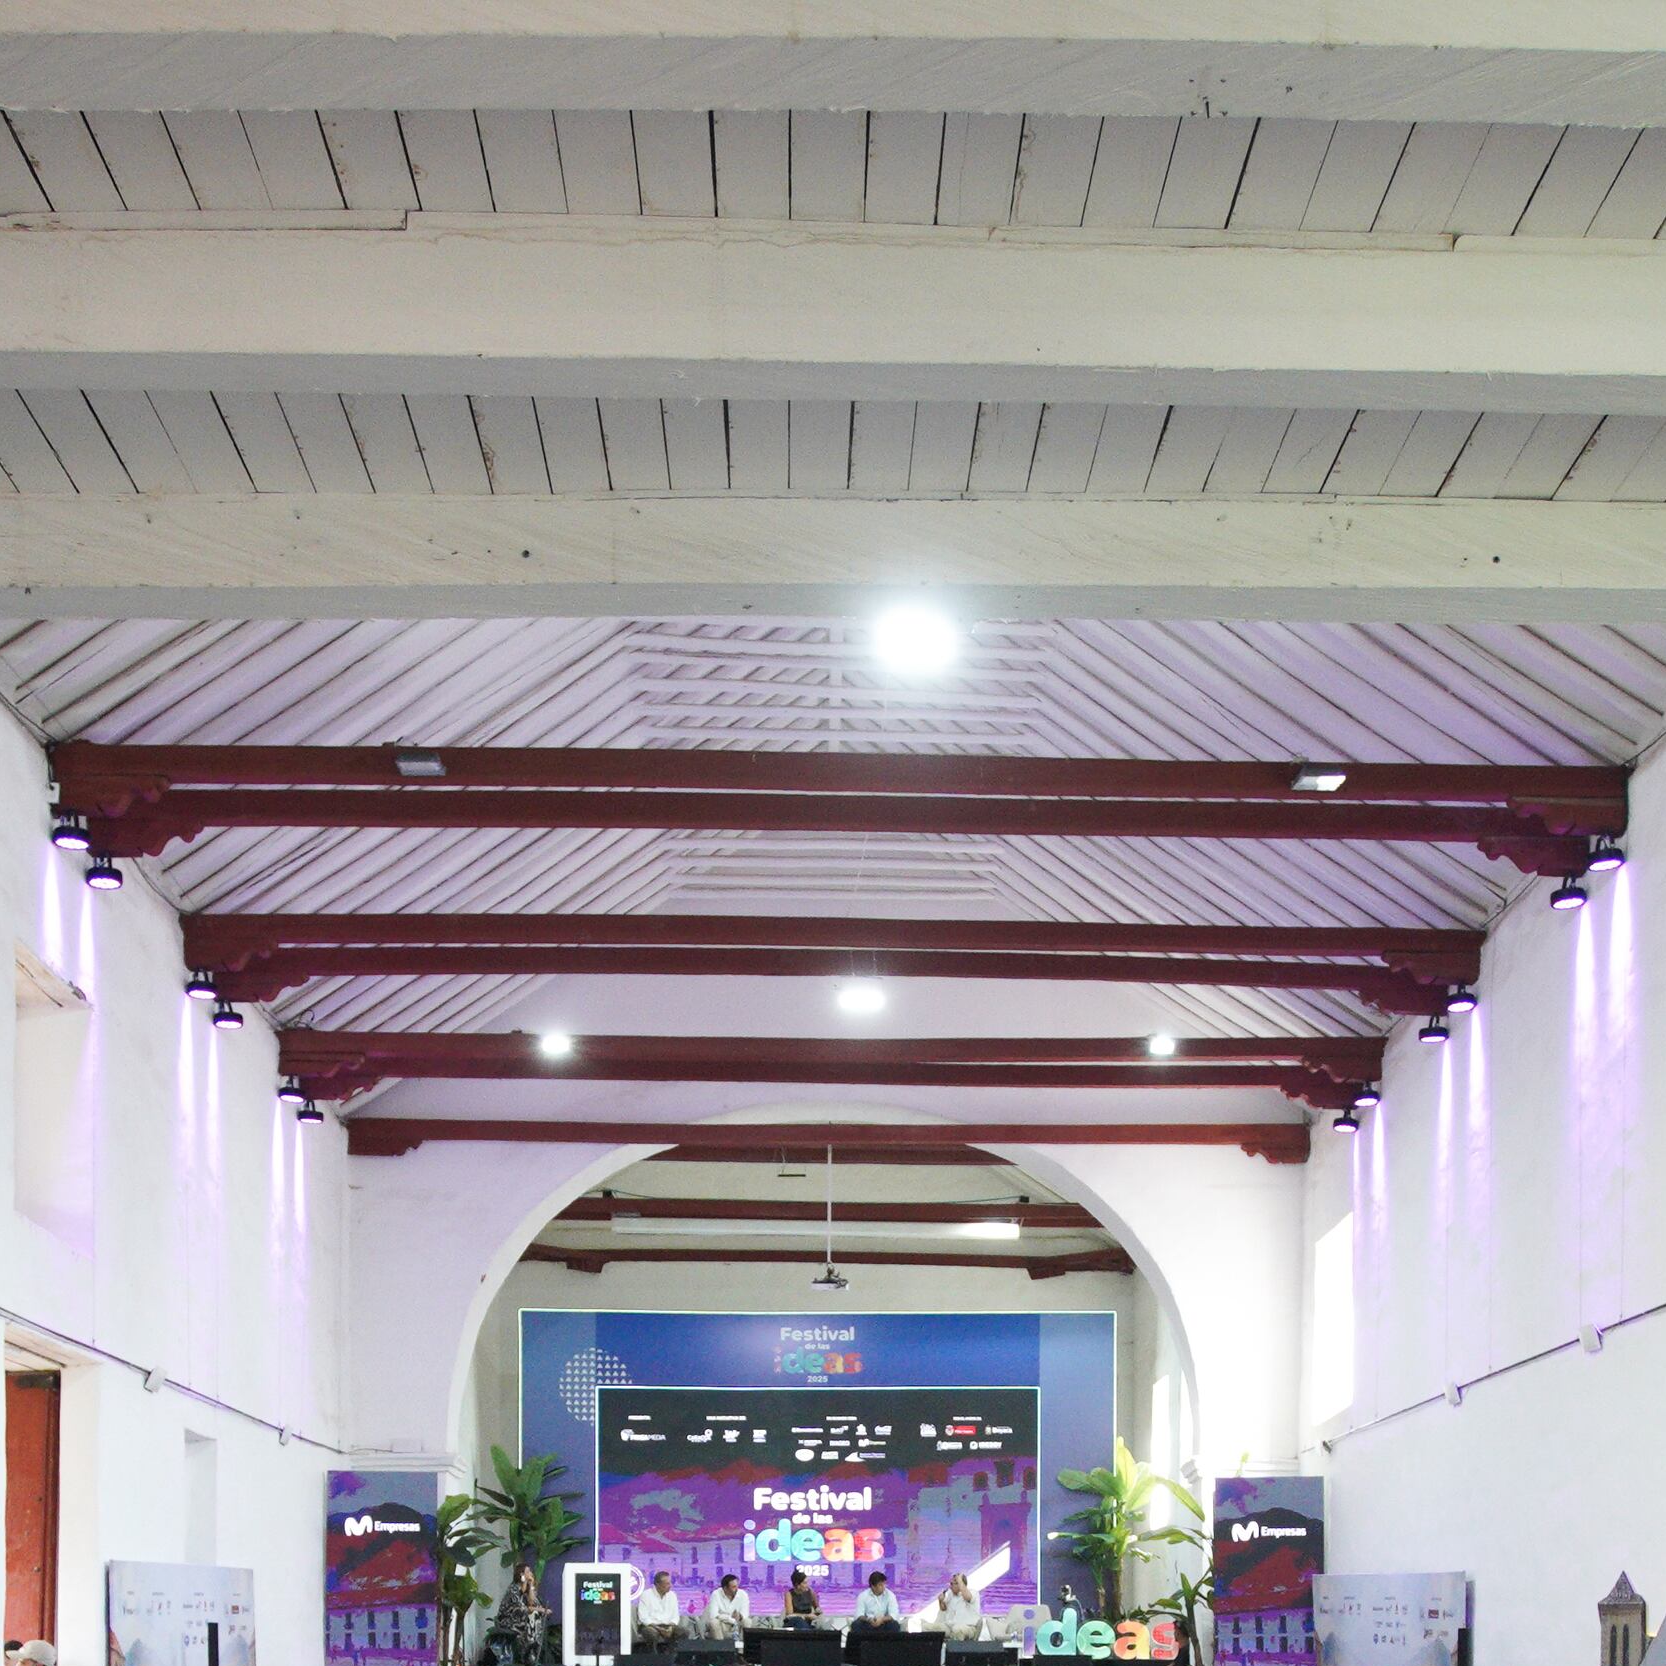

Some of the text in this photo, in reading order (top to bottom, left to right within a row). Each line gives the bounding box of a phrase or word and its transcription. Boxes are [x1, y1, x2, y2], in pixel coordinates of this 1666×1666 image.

[780, 1325, 855, 1341] Festival
[773, 1346, 862, 1374] ideas
[807, 1375, 829, 1383] 2025
[753, 1484, 872, 1511] Festival
[792, 1512, 833, 1524] de las
[374, 1520, 421, 1533] Empresas
[1260, 1526, 1307, 1539] Empresas
[743, 1518, 884, 1562] ideas
[796, 1565, 829, 1576] 2025
[1023, 1607, 1180, 1660] ideas
